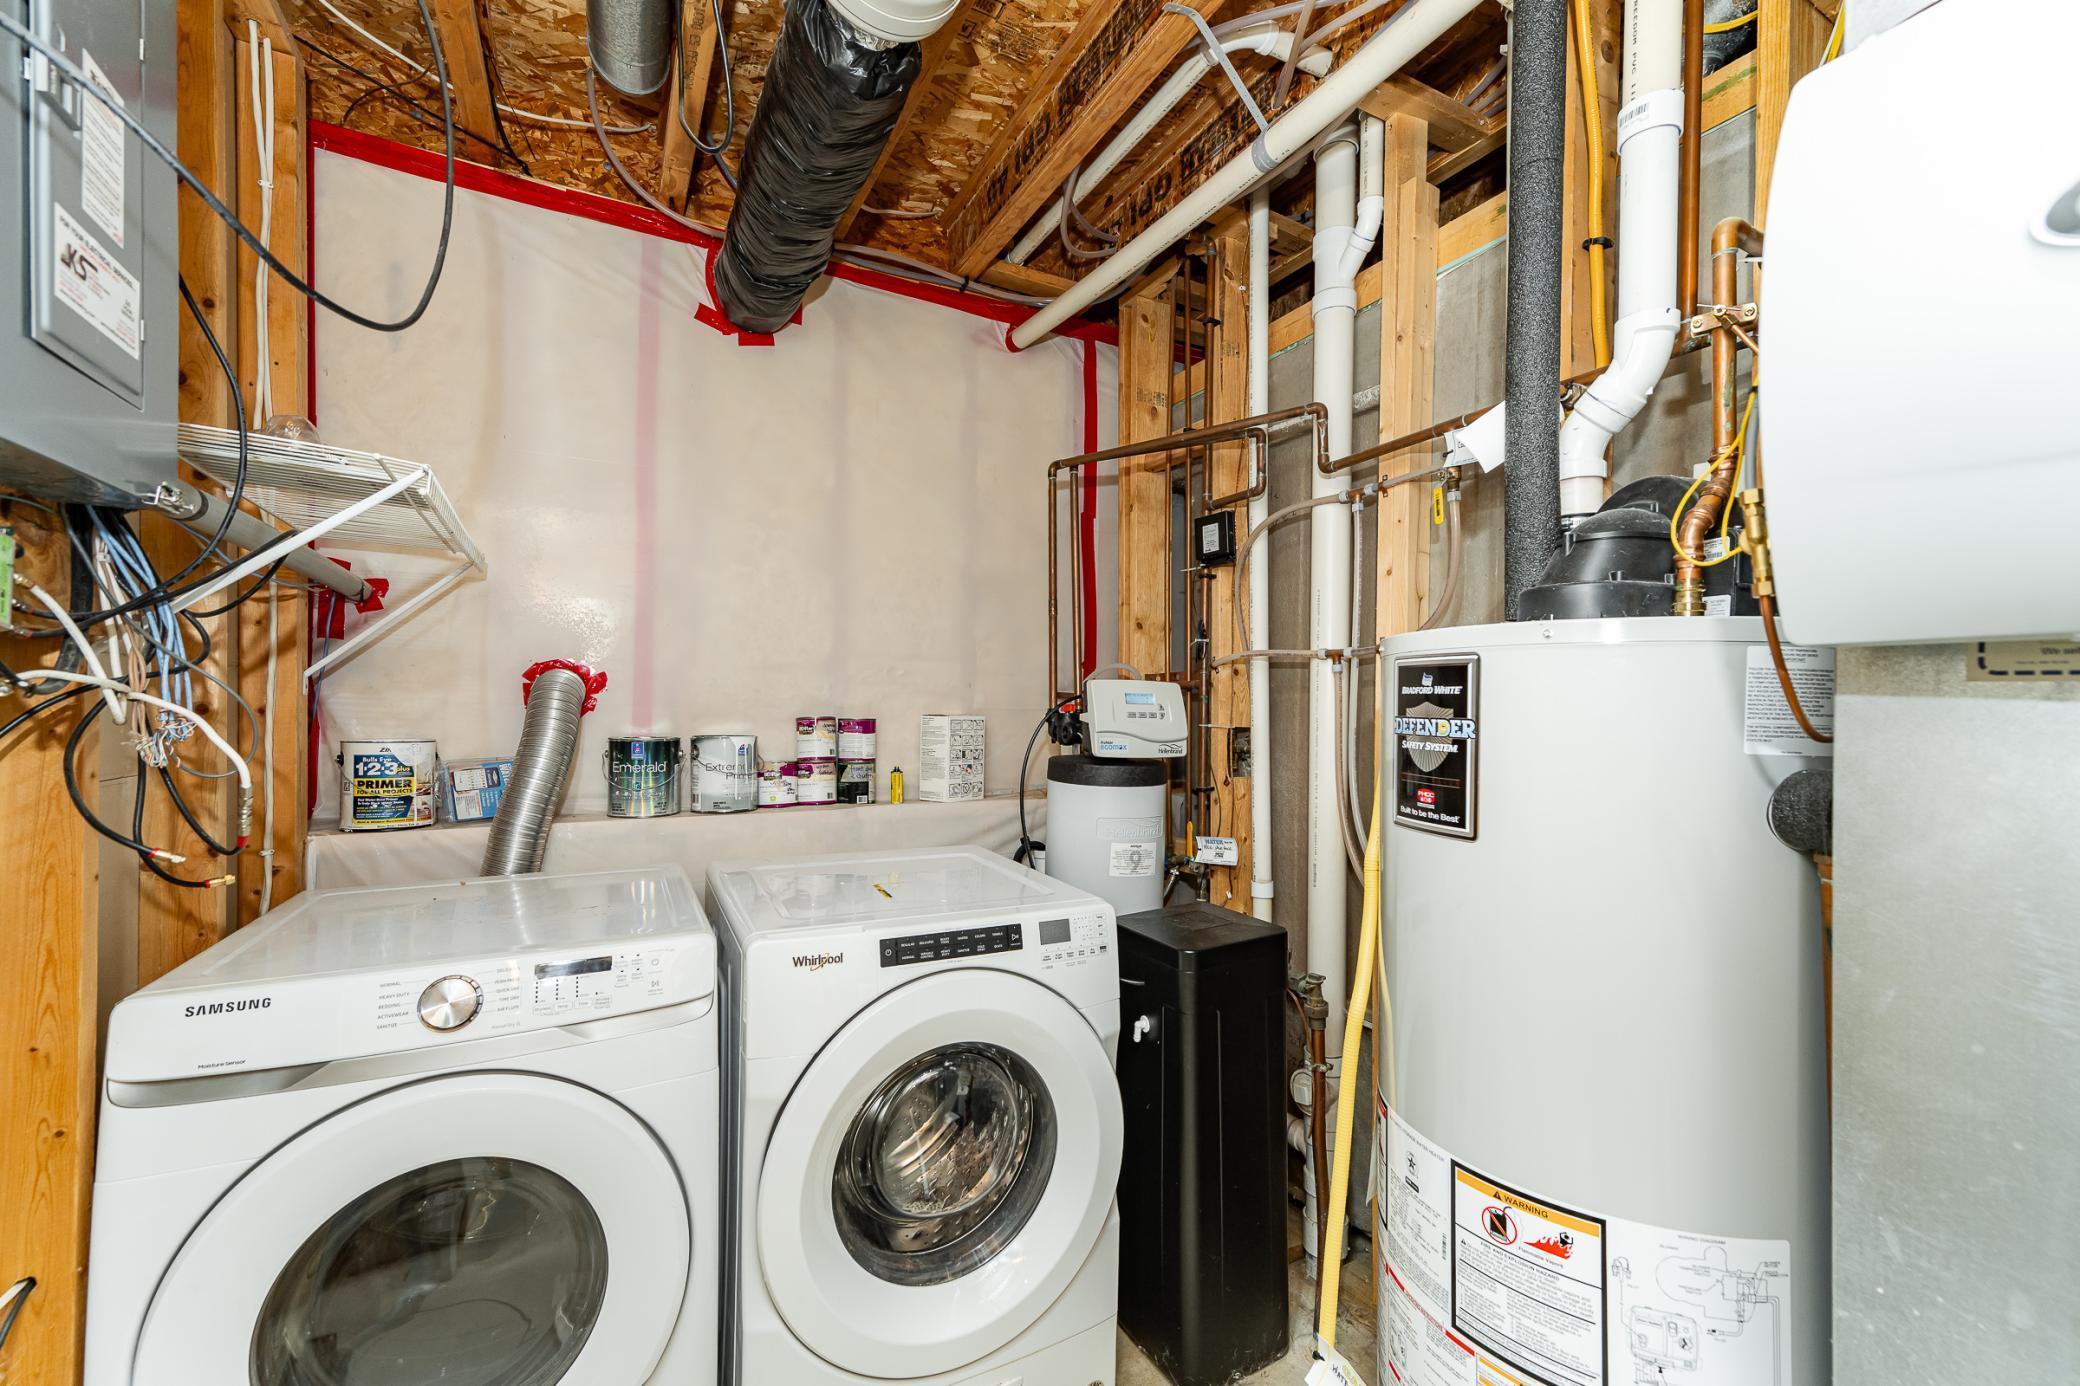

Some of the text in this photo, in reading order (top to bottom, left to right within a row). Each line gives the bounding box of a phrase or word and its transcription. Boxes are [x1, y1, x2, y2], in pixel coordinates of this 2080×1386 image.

[1402, 686, 1461, 694] BRADFORD WHITE
[1394, 717, 1476, 738] DEFENDER
[1402, 740, 1424, 750] SAFETY
[612, 762, 666, 774] Emerald
[356, 779, 412, 790] PRIMER
[1400, 805, 1411, 814] Built
[1418, 809, 1427, 817] be
[1428, 810, 1439, 820] the
[792, 952, 843, 967] Whirlpool
[185, 998, 272, 1018] SAMSUNG
[1504, 1195, 1548, 1219] WARNING
